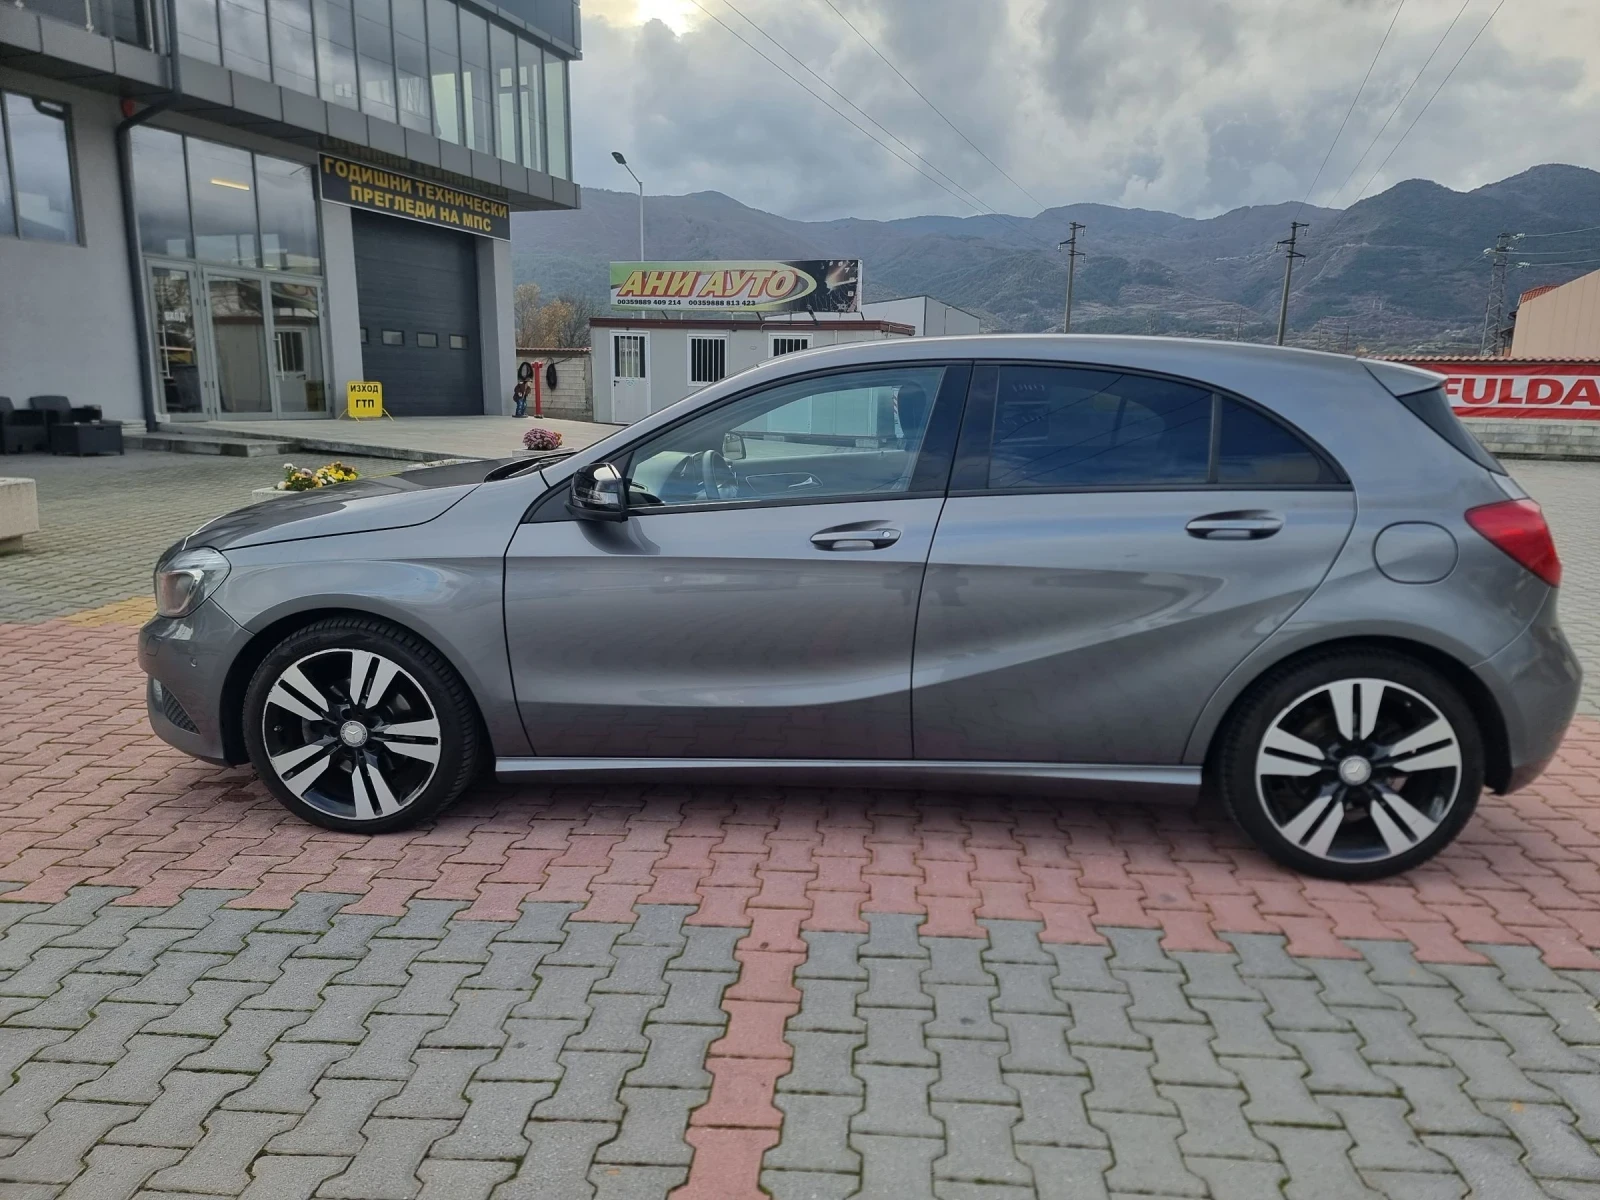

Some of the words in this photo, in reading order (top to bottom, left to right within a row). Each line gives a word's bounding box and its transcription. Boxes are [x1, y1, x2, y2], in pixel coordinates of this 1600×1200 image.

[323, 157, 413, 194] ГОДИШНИ
[415, 181, 508, 219] ТЕХНИЧЕСКИ
[350, 185, 436, 219] ПРЕГЛЕДИ
[439, 208, 460, 225] НА
[462, 212, 492, 232] МПС
[616, 270, 700, 298] АНИ
[696, 269, 798, 298] АУТО
[350, 384, 379, 394] ИЗХОД
[355, 398, 375, 409] ГТП
